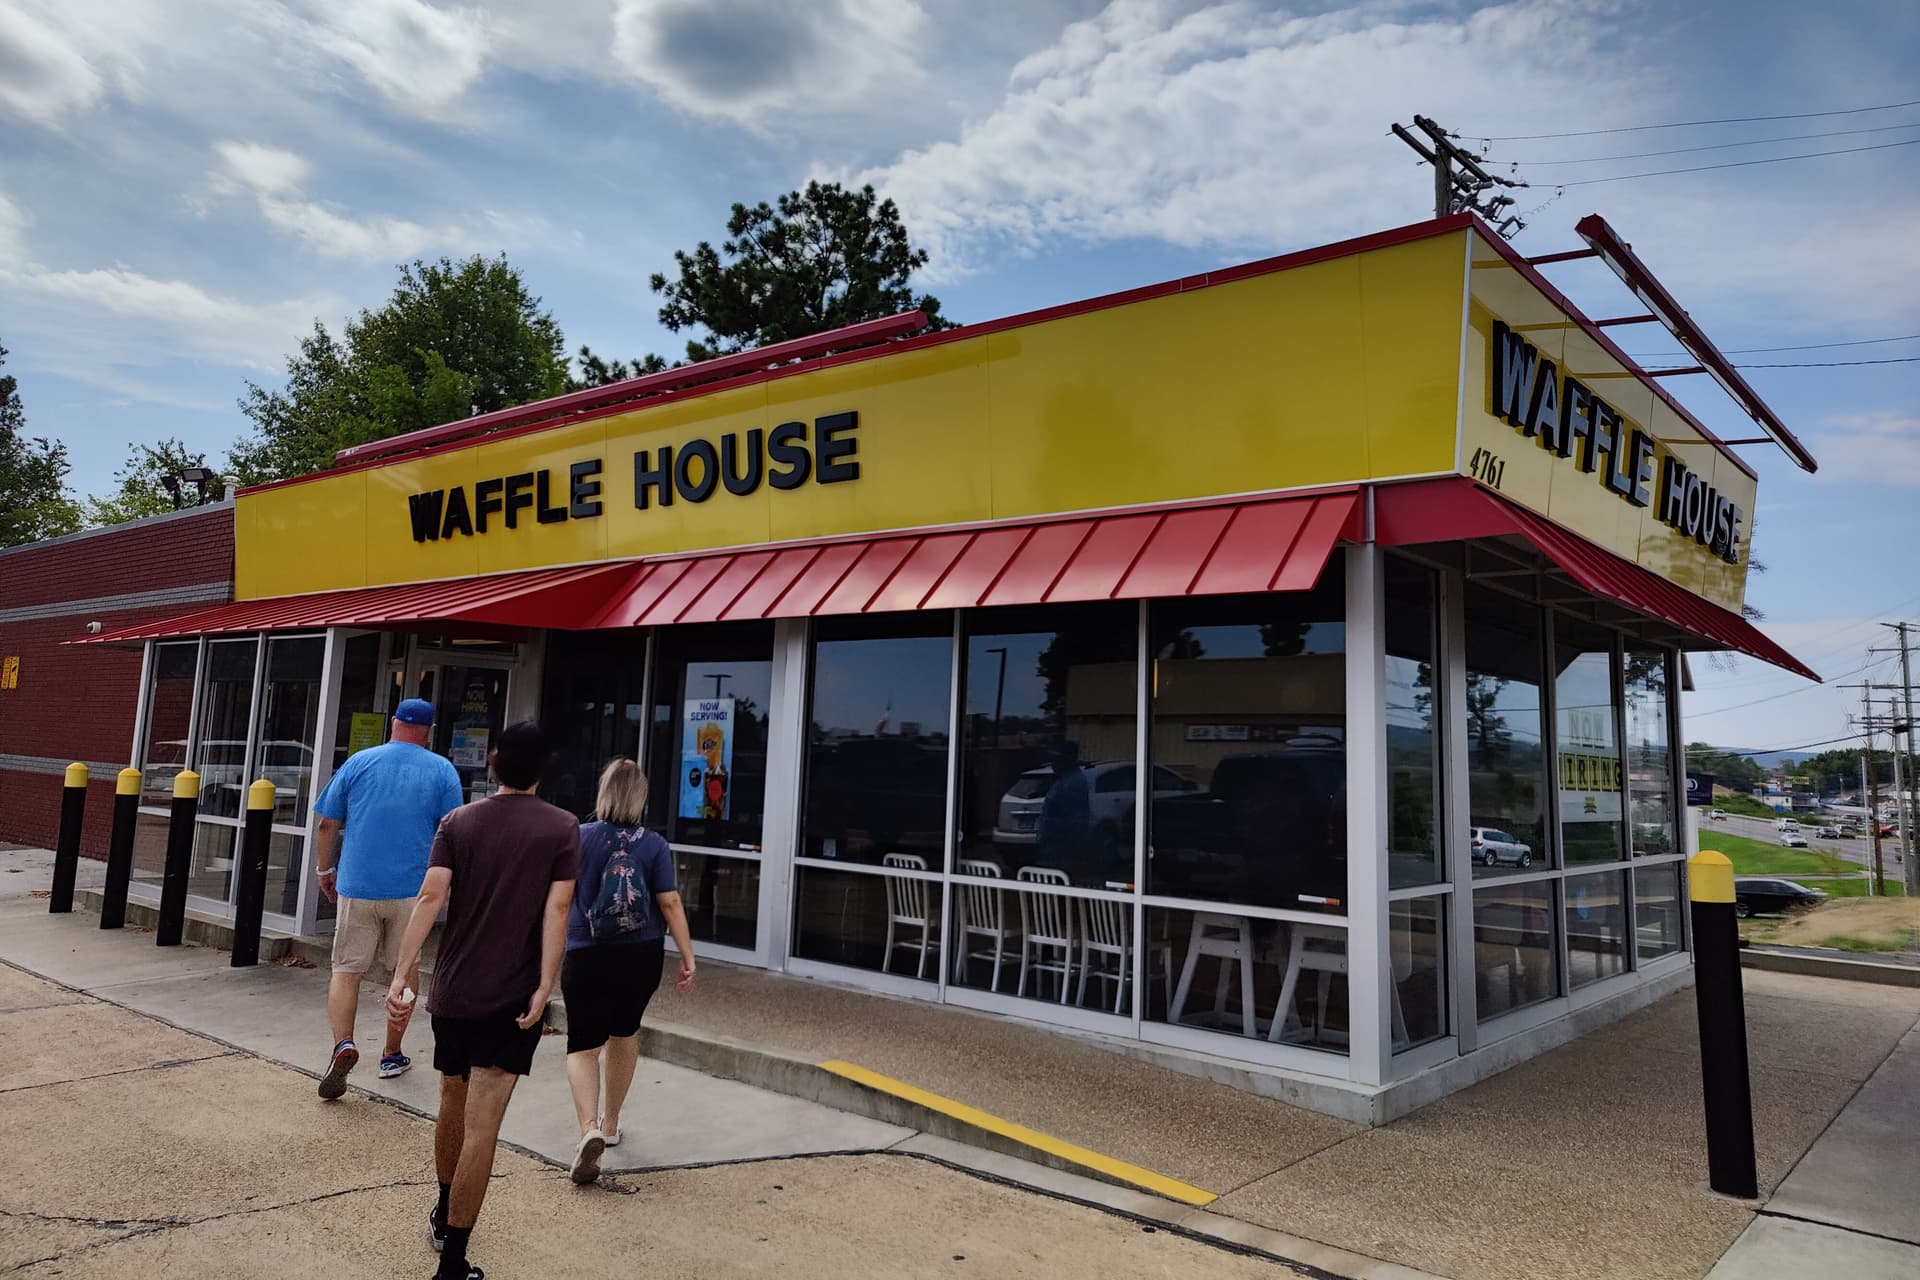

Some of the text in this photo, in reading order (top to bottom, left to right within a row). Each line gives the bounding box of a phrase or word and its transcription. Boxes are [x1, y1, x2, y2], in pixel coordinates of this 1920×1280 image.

[1492, 319, 1743, 564] WAFFLE HOUSE
[408, 410, 861, 543] WAFFLE HOUSE
[1470, 447, 1505, 490] 4761
[690, 711, 728, 721] SERVING!
[700, 702, 719, 712] NOW
[1569, 712, 1605, 742] NOW
[1559, 755, 1622, 789] IRING
